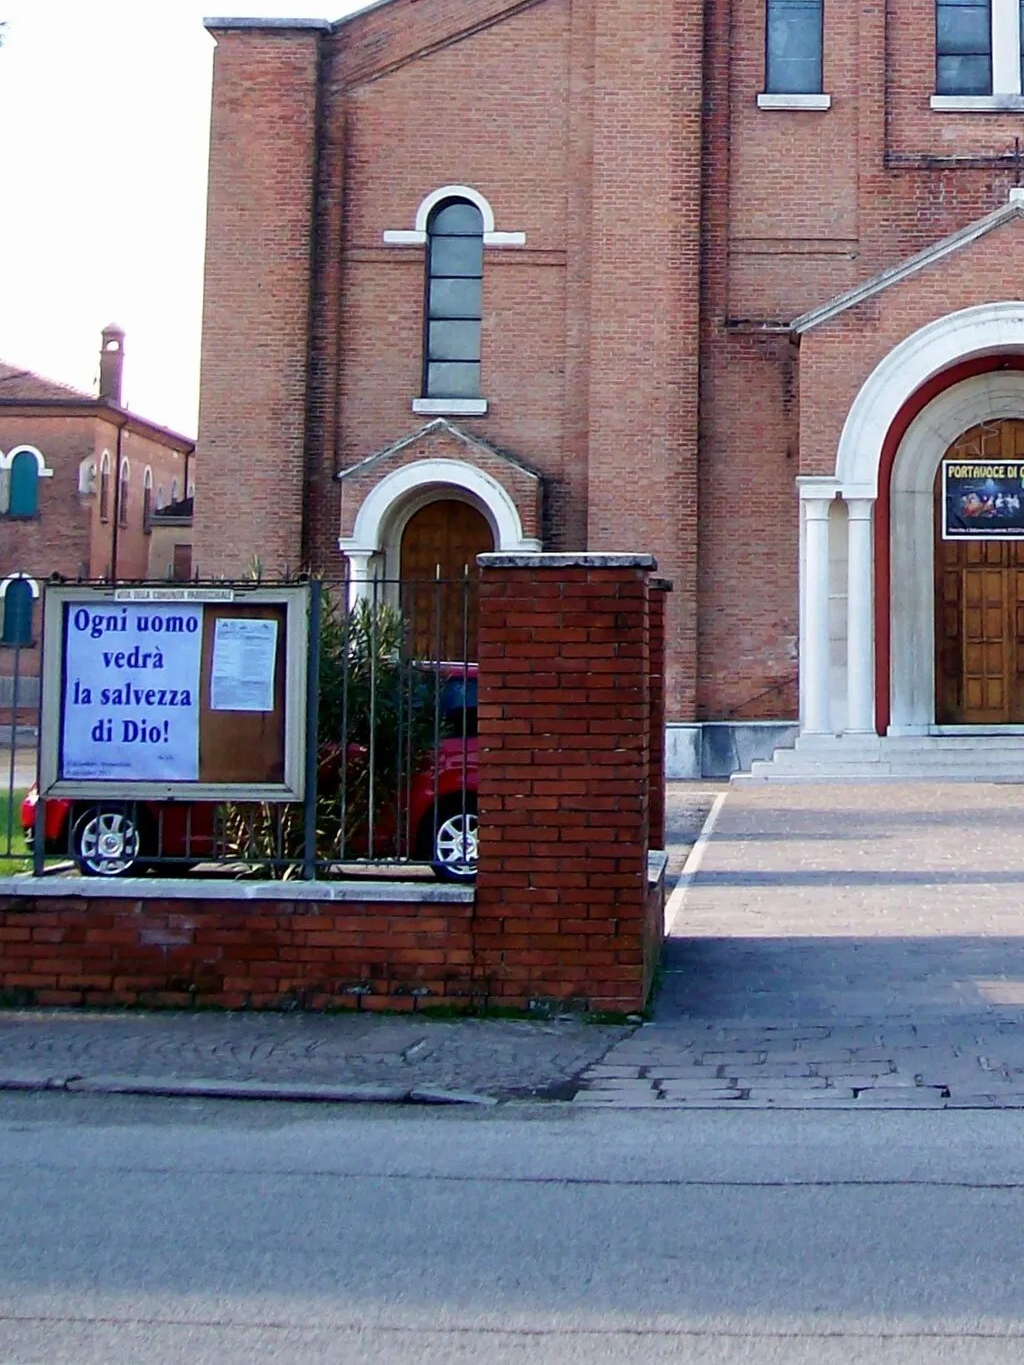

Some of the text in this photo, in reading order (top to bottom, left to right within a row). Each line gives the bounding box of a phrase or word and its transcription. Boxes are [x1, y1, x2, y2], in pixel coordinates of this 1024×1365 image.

[948, 465, 1005, 478] PORTAVOCE
[1007, 465, 1018, 478] DI
[74, 608, 128, 639] Ogni
[136, 615, 198, 633] uomo
[102, 645, 164, 669] vedrà
[72, 681, 92, 705] la
[100, 682, 192, 706] salvezza
[91, 719, 169, 744] di Dio!
